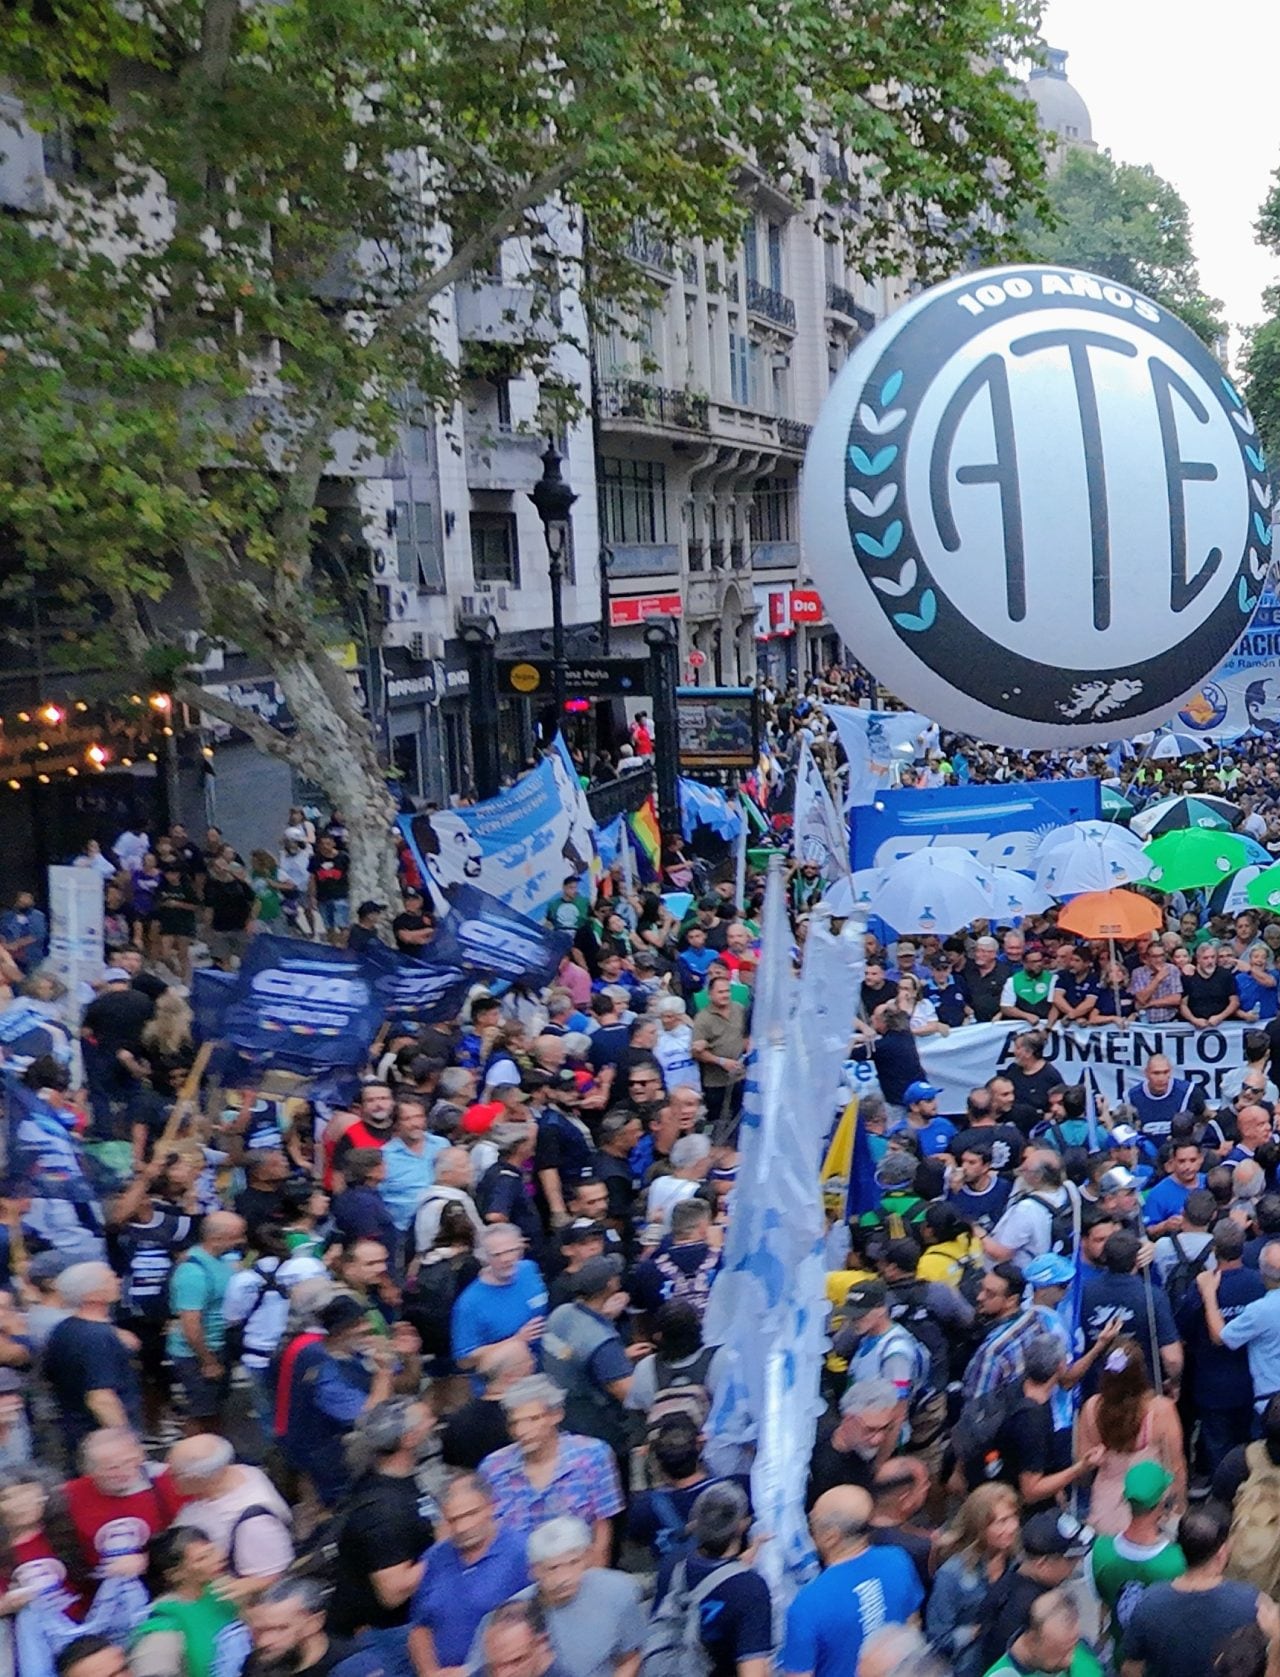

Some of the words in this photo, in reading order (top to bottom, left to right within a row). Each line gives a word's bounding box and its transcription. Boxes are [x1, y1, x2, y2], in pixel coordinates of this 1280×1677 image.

[957, 277, 1034, 317] 100
[1040, 273, 1161, 323] AÑOS
[928, 327, 1223, 632] ATE
[1238, 658, 1275, 668] Ramón
